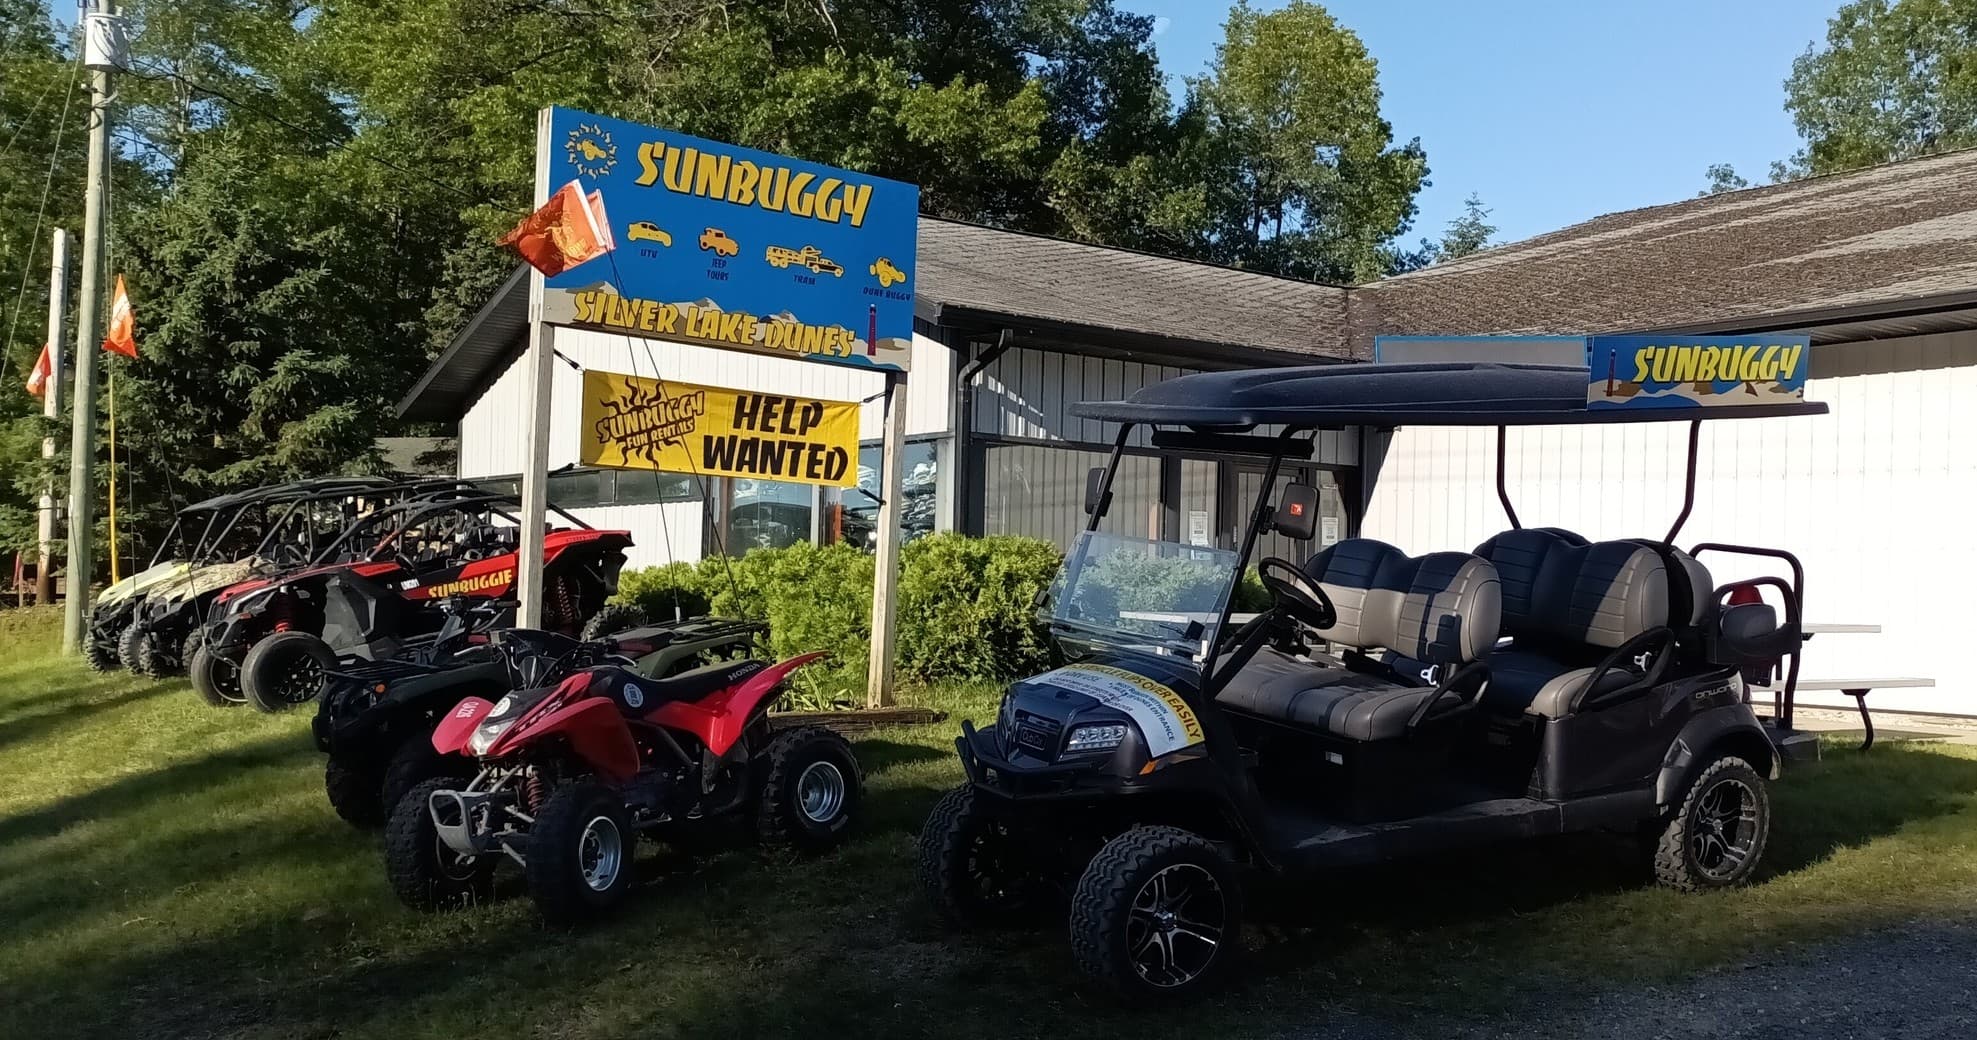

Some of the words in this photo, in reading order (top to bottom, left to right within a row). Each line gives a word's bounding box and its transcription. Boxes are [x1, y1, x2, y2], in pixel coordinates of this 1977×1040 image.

[634, 141, 872, 228] SUNBUGGY
[640, 248, 658, 259] UTV
[711, 258, 727, 269] JEEP
[706, 269, 729, 281] TOURS
[793, 275, 816, 286] TRAM
[863, 286, 884, 298] DUNE
[885, 290, 912, 301] BUGGY
[573, 290, 679, 334] SILVER
[685, 304, 757, 345] LAKE
[764, 321, 856, 358] DUNES
[1632, 345, 1802, 383] SUNBUGGY
[595, 390, 705, 444] SUNBUGGY
[733, 394, 824, 436] HELP
[626, 432, 648, 450] FUN
[650, 418, 694, 443] RENTALS
[702, 434, 849, 481] WANTED
[428, 569, 512, 598] SUNBUGGIE
[728, 663, 761, 681] HONDA
[1119, 671, 1144, 684] FLIPS
[1142, 681, 1171, 699] OVER
[1167, 698, 1201, 739] EASILY
